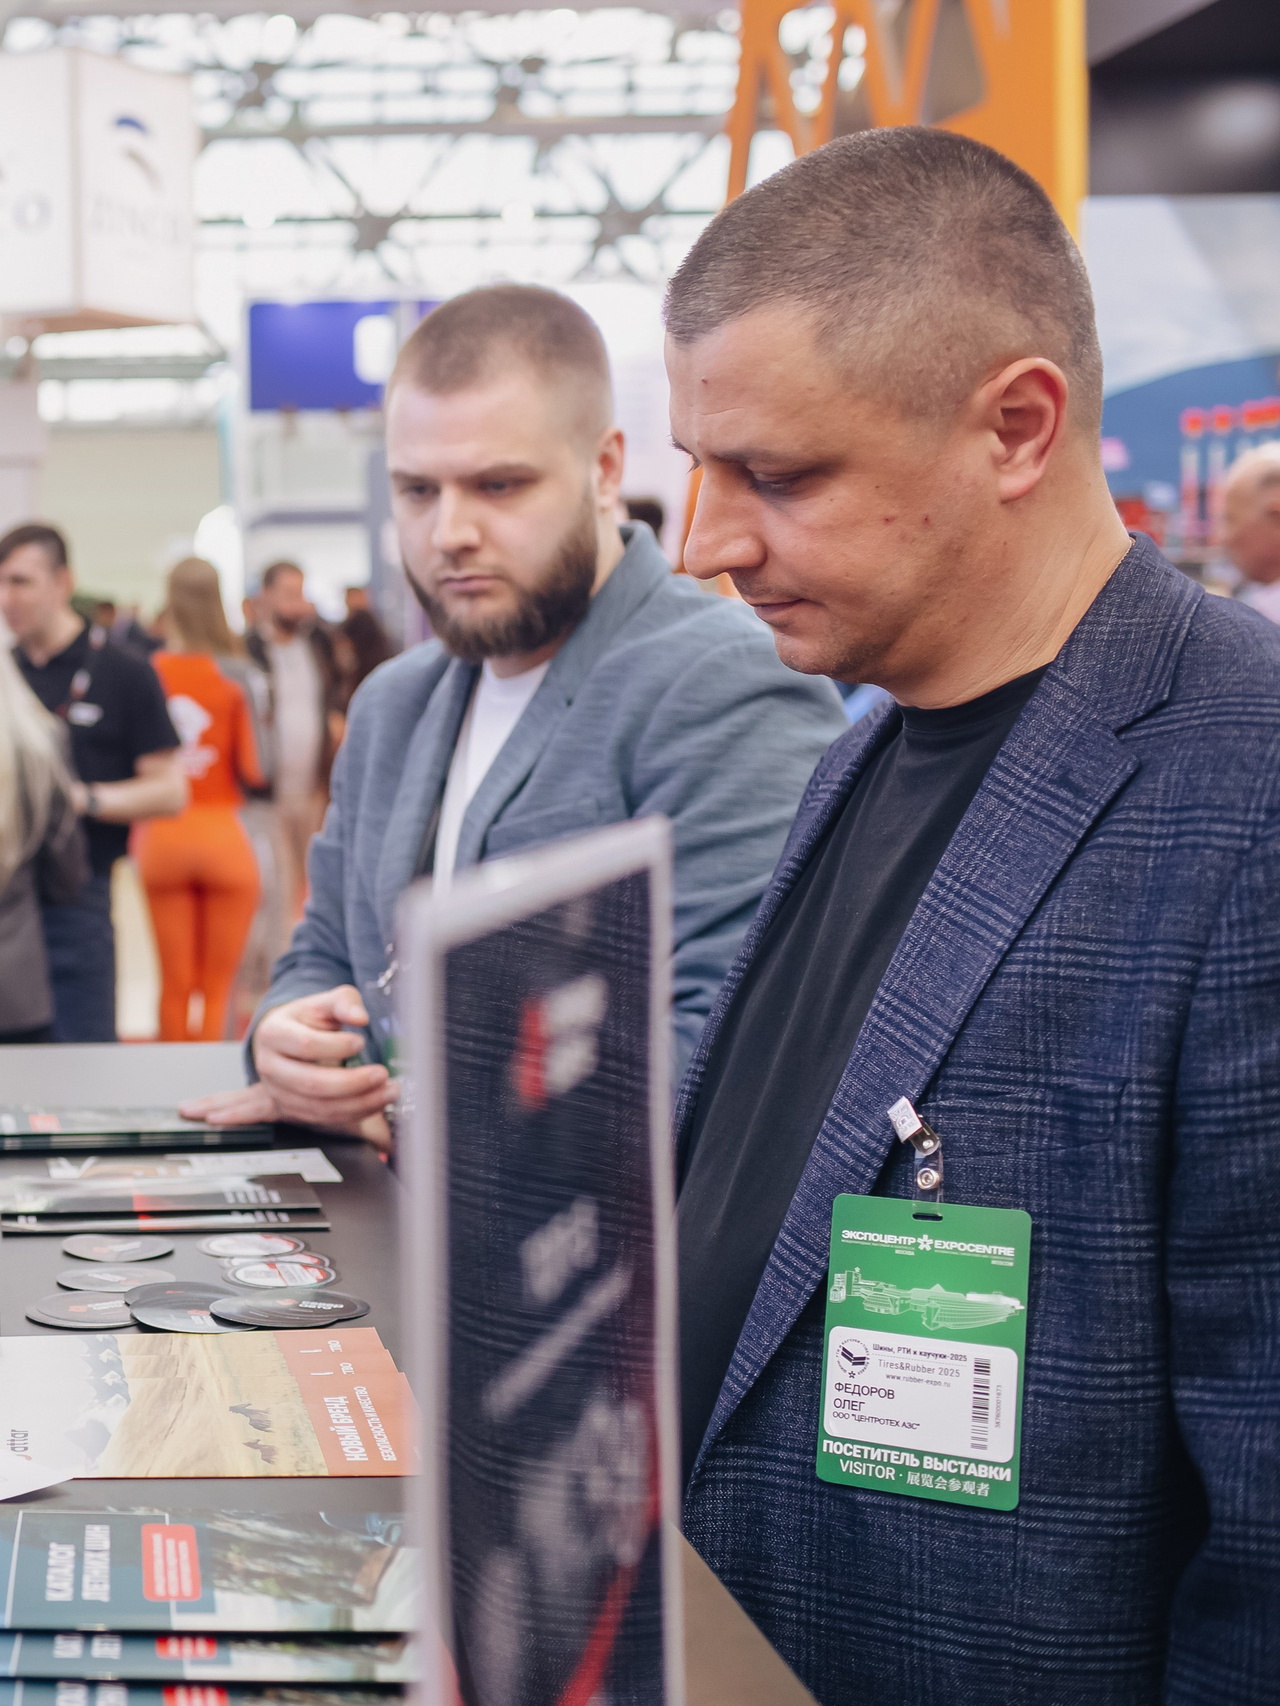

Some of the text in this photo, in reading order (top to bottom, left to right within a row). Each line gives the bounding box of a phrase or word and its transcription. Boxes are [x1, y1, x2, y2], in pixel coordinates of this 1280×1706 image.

[841, 1229, 916, 1245] ЭКСПОЦЕНТР
[934, 1240, 1015, 1257] EXPOCENTRE
[872, 1343, 895, 1354] Шины,
[897, 1346, 911, 1355] РТИ
[878, 1359, 960, 1378] Tires&Rubber 2025
[885, 1373, 951, 1388] www.rubber-expo.ru
[353, 1385, 376, 1413] КАЧЕСТВО
[833, 1398, 866, 1411] ОЛЕГ
[834, 1382, 895, 1400] ФЕДОРОВ
[323, 1396, 354, 1424] БРЕНД
[832, 1411, 921, 1430] ООО "ЦЕНТРОТЕХ АЗС"
[329, 1425, 368, 1462] НОВЫЙ
[366, 1417, 397, 1462] БЕЗОПАСНОСТЬ
[822, 1439, 1012, 1482] ПОСЕТИТЕЛЬ ВЫСТАВКИ
[839, 1458, 990, 1497] VISITOR 展览会参观者
[84, 1524, 110, 1550] ШИН
[44, 1542, 76, 1602] КАТАЛОГ
[81, 1549, 110, 1603] ЛЕТНИХ
